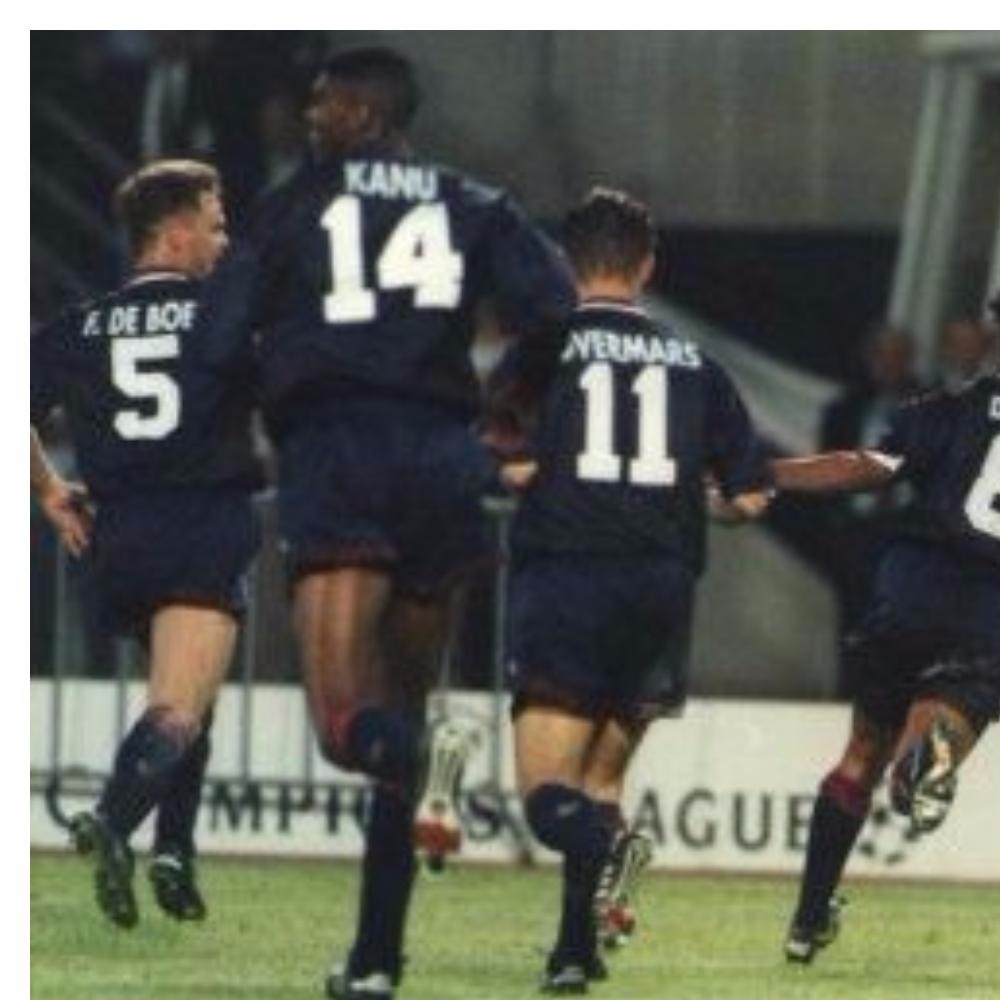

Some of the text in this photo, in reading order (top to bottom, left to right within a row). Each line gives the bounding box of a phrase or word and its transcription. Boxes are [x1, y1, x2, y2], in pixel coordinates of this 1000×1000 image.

[344, 161, 438, 200] KANU
[321, 194, 463, 323] 14
[107, 305, 140, 336] DE
[110, 335, 180, 440] 5
[577, 361, 677, 486] 11
[630, 786, 812, 852] AGUE
